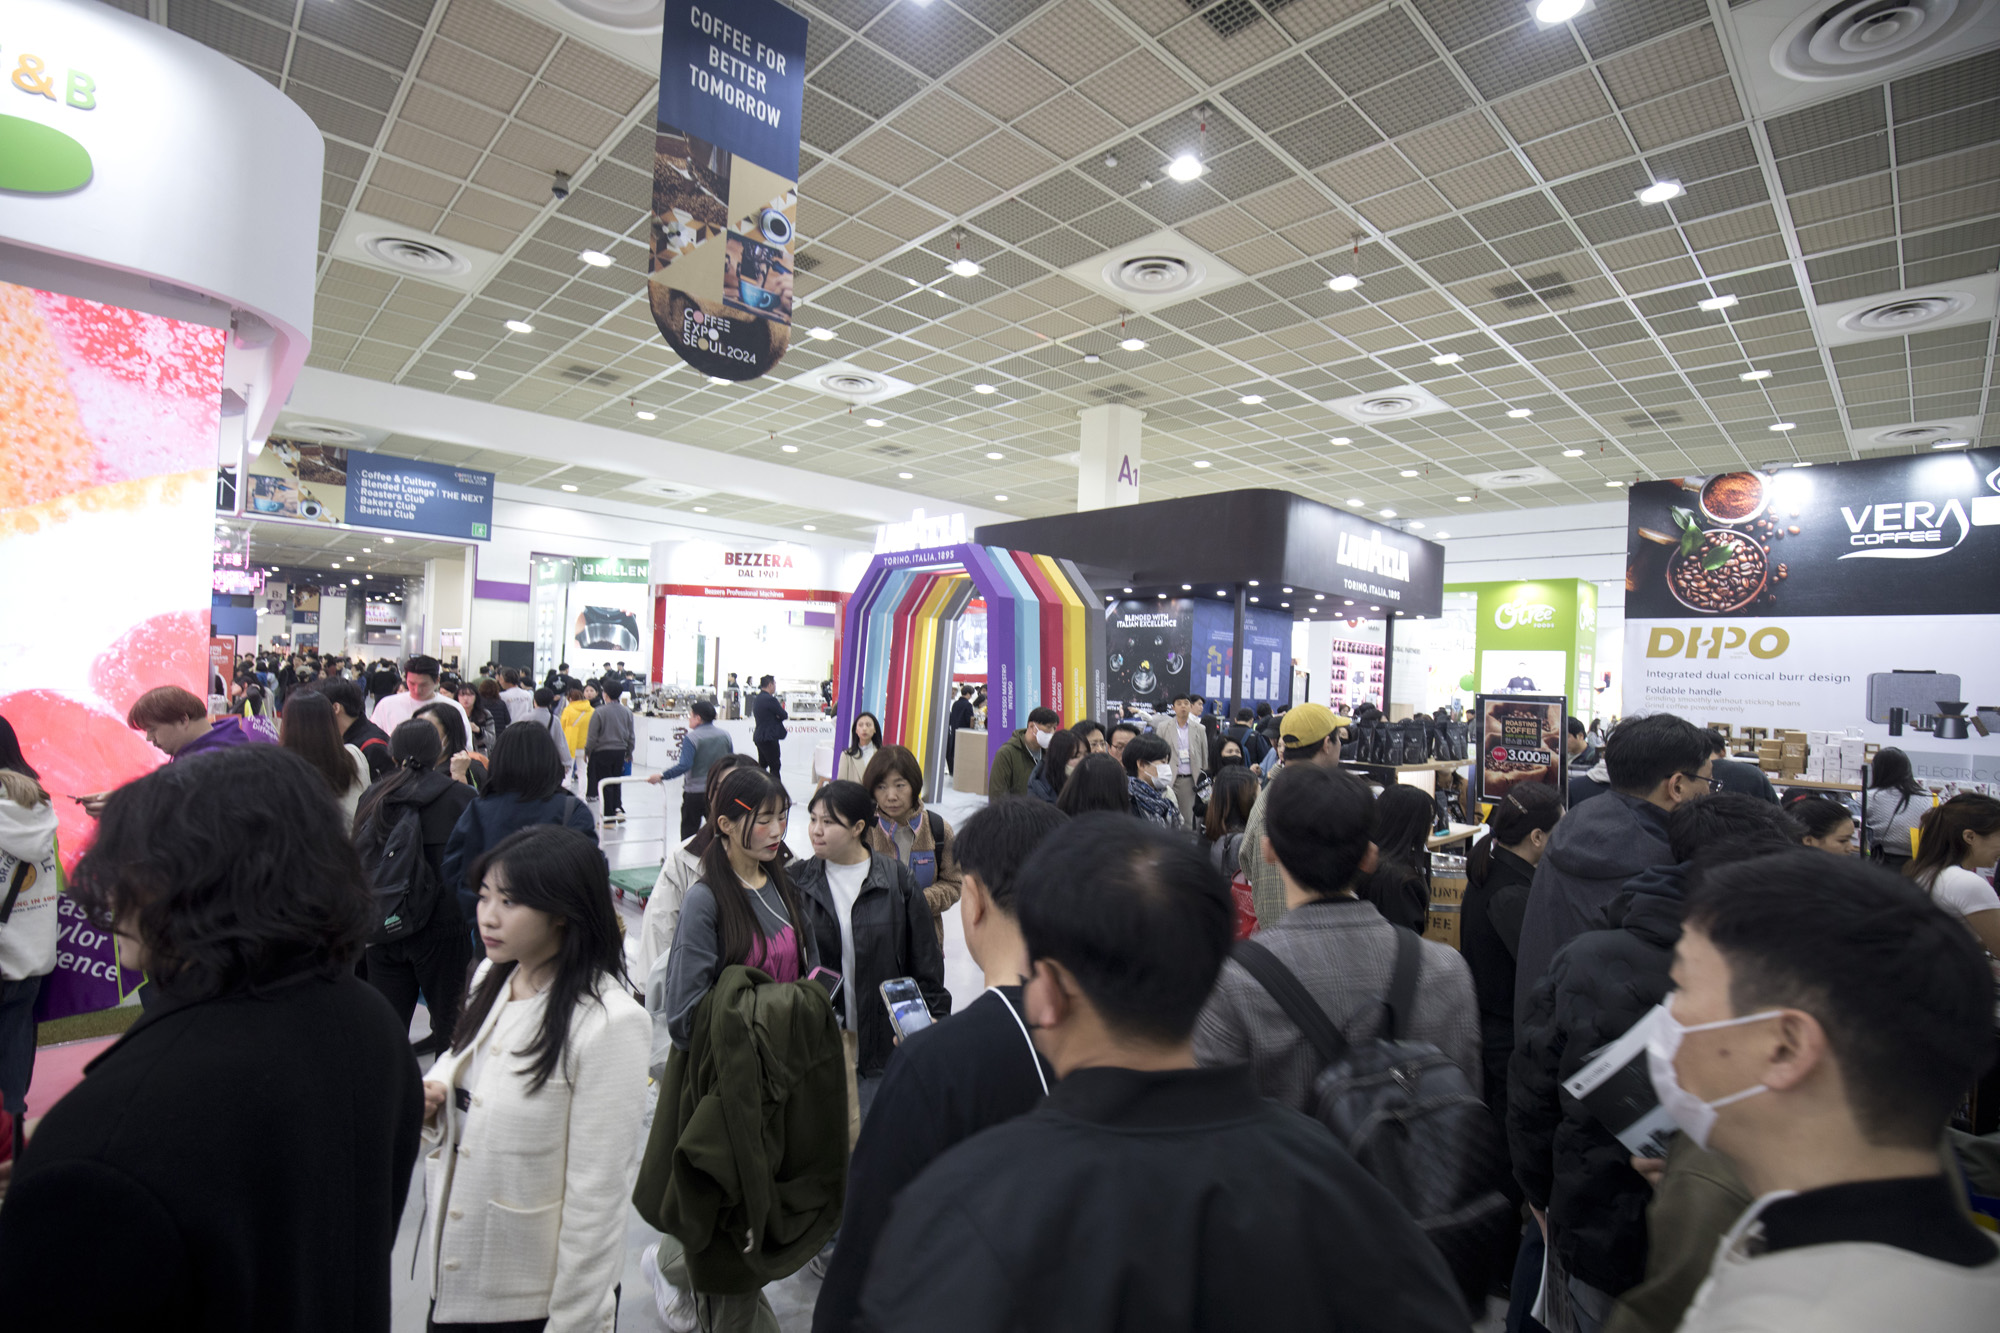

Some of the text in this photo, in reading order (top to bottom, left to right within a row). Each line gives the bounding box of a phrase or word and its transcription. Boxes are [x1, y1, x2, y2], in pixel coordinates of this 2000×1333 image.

[690, 5, 787, 76] COFFEE FOR
[709, 44, 767, 94] BETTER
[689, 63, 781, 128] TOMORROW
[684, 307, 731, 333] COFFEE
[683, 320, 719, 341] EXPO
[1118, 454, 1138, 487] A1
[361, 469, 437, 489] Coffee & Culture
[360, 487, 425, 504] Roasters Club
[361, 478, 484, 504] Blended Lounge THE NEXT
[360, 496, 416, 512] Bakers Club
[360, 504, 415, 520] Bartist Club
[1840, 499, 1970, 541] VERA
[1850, 530, 1941, 546] COFFEE
[724, 552, 793, 568] BEZZERA
[938, 550, 954, 561] 1895
[595, 563, 649, 577] MILLEN
[738, 569, 779, 579] DAL 1901
[704, 587, 784, 598] Bezzera Professional Machines
[1388, 589, 1400, 600] 1895
[1117, 619, 1177, 628] ITALIAN EXCELLENCE
[1125, 613, 1168, 621] BLENDED WITH
[1646, 670, 1850, 684] Integrated dual conical burr design
[1646, 686, 1722, 696] Foldable handle
[1645, 695, 1801, 707] Grinding smoothly without sticking beans
[795, 726, 819, 734] LOVERS
[1505, 720, 1538, 728] ROASTING
[1505, 727, 1537, 735] COFFEE
[57, 950, 118, 982] ence
